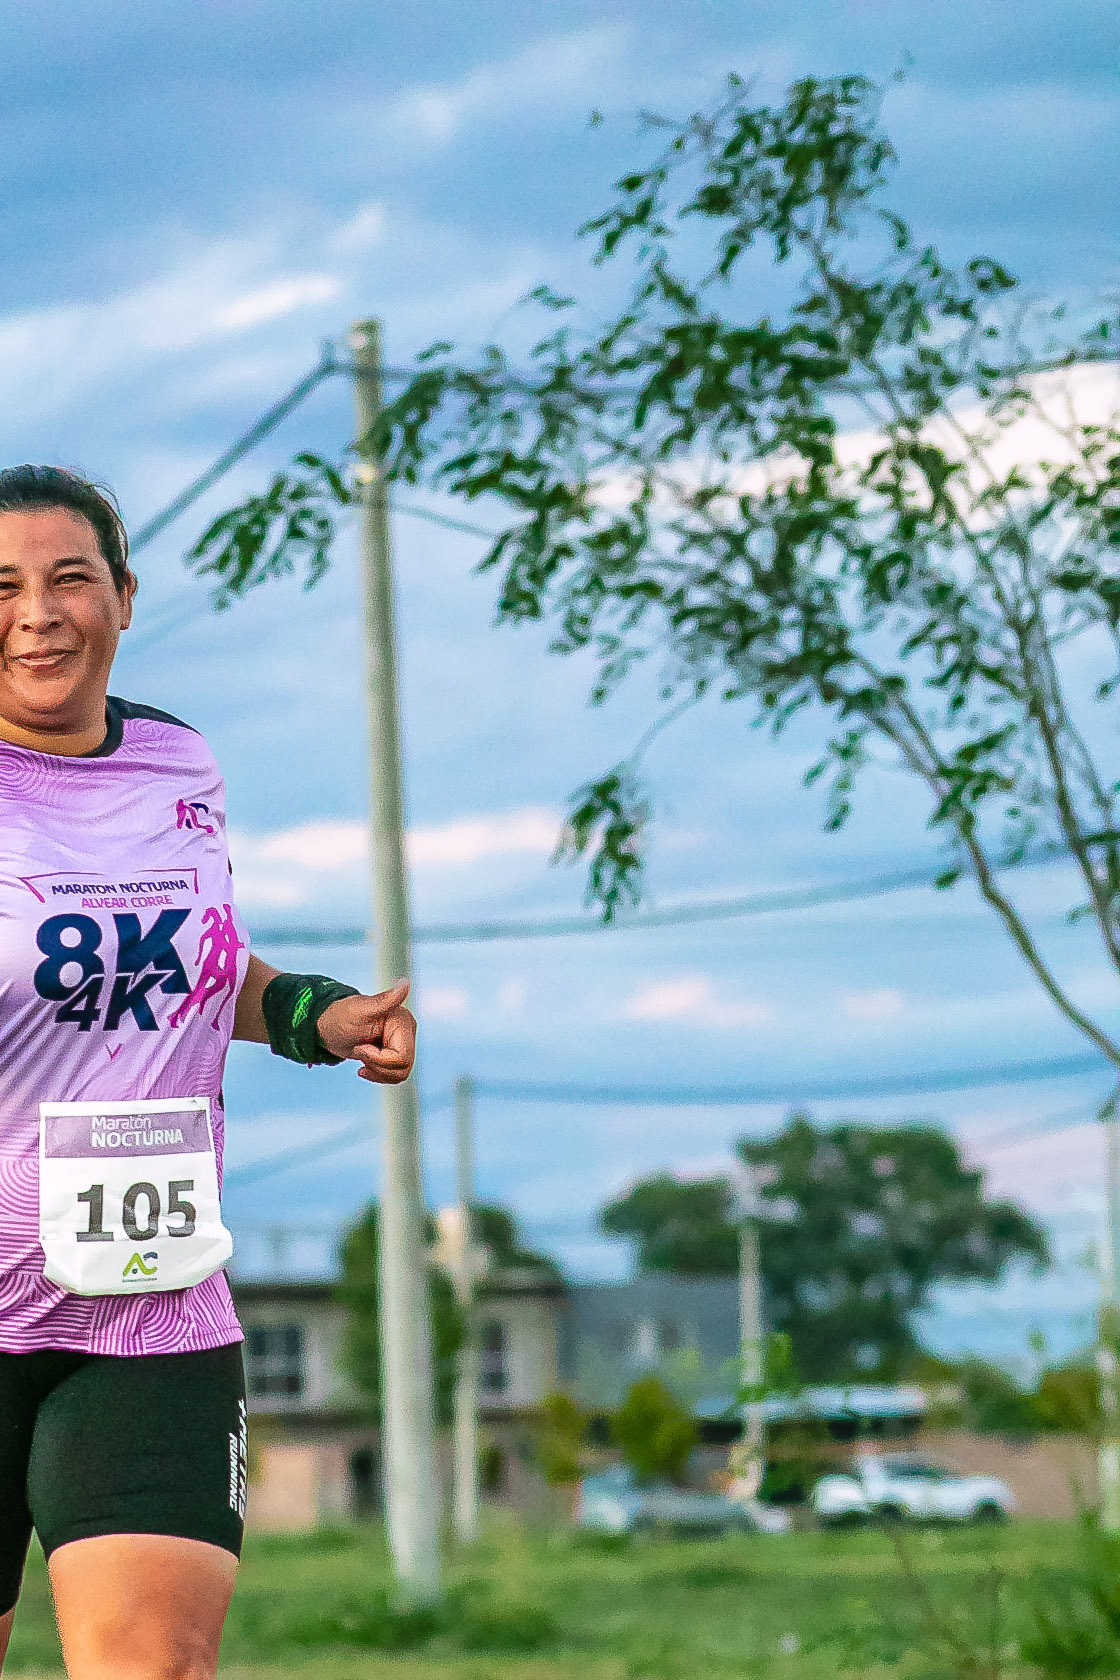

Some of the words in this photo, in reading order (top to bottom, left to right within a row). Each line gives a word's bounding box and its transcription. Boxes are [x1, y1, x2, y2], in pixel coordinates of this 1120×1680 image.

[51, 883, 118, 895] MARATON
[119, 879, 189, 894] NOCTURNA
[81, 897, 129, 908] ALVEAR
[130, 894, 174, 907] CORRE
[33, 907, 193, 1002] 8K
[54, 972, 161, 1032] 4K
[91, 1128, 185, 1148] NOCTURNA
[76, 1179, 197, 1243] 105
[229, 1432, 238, 1512] RUNNING
